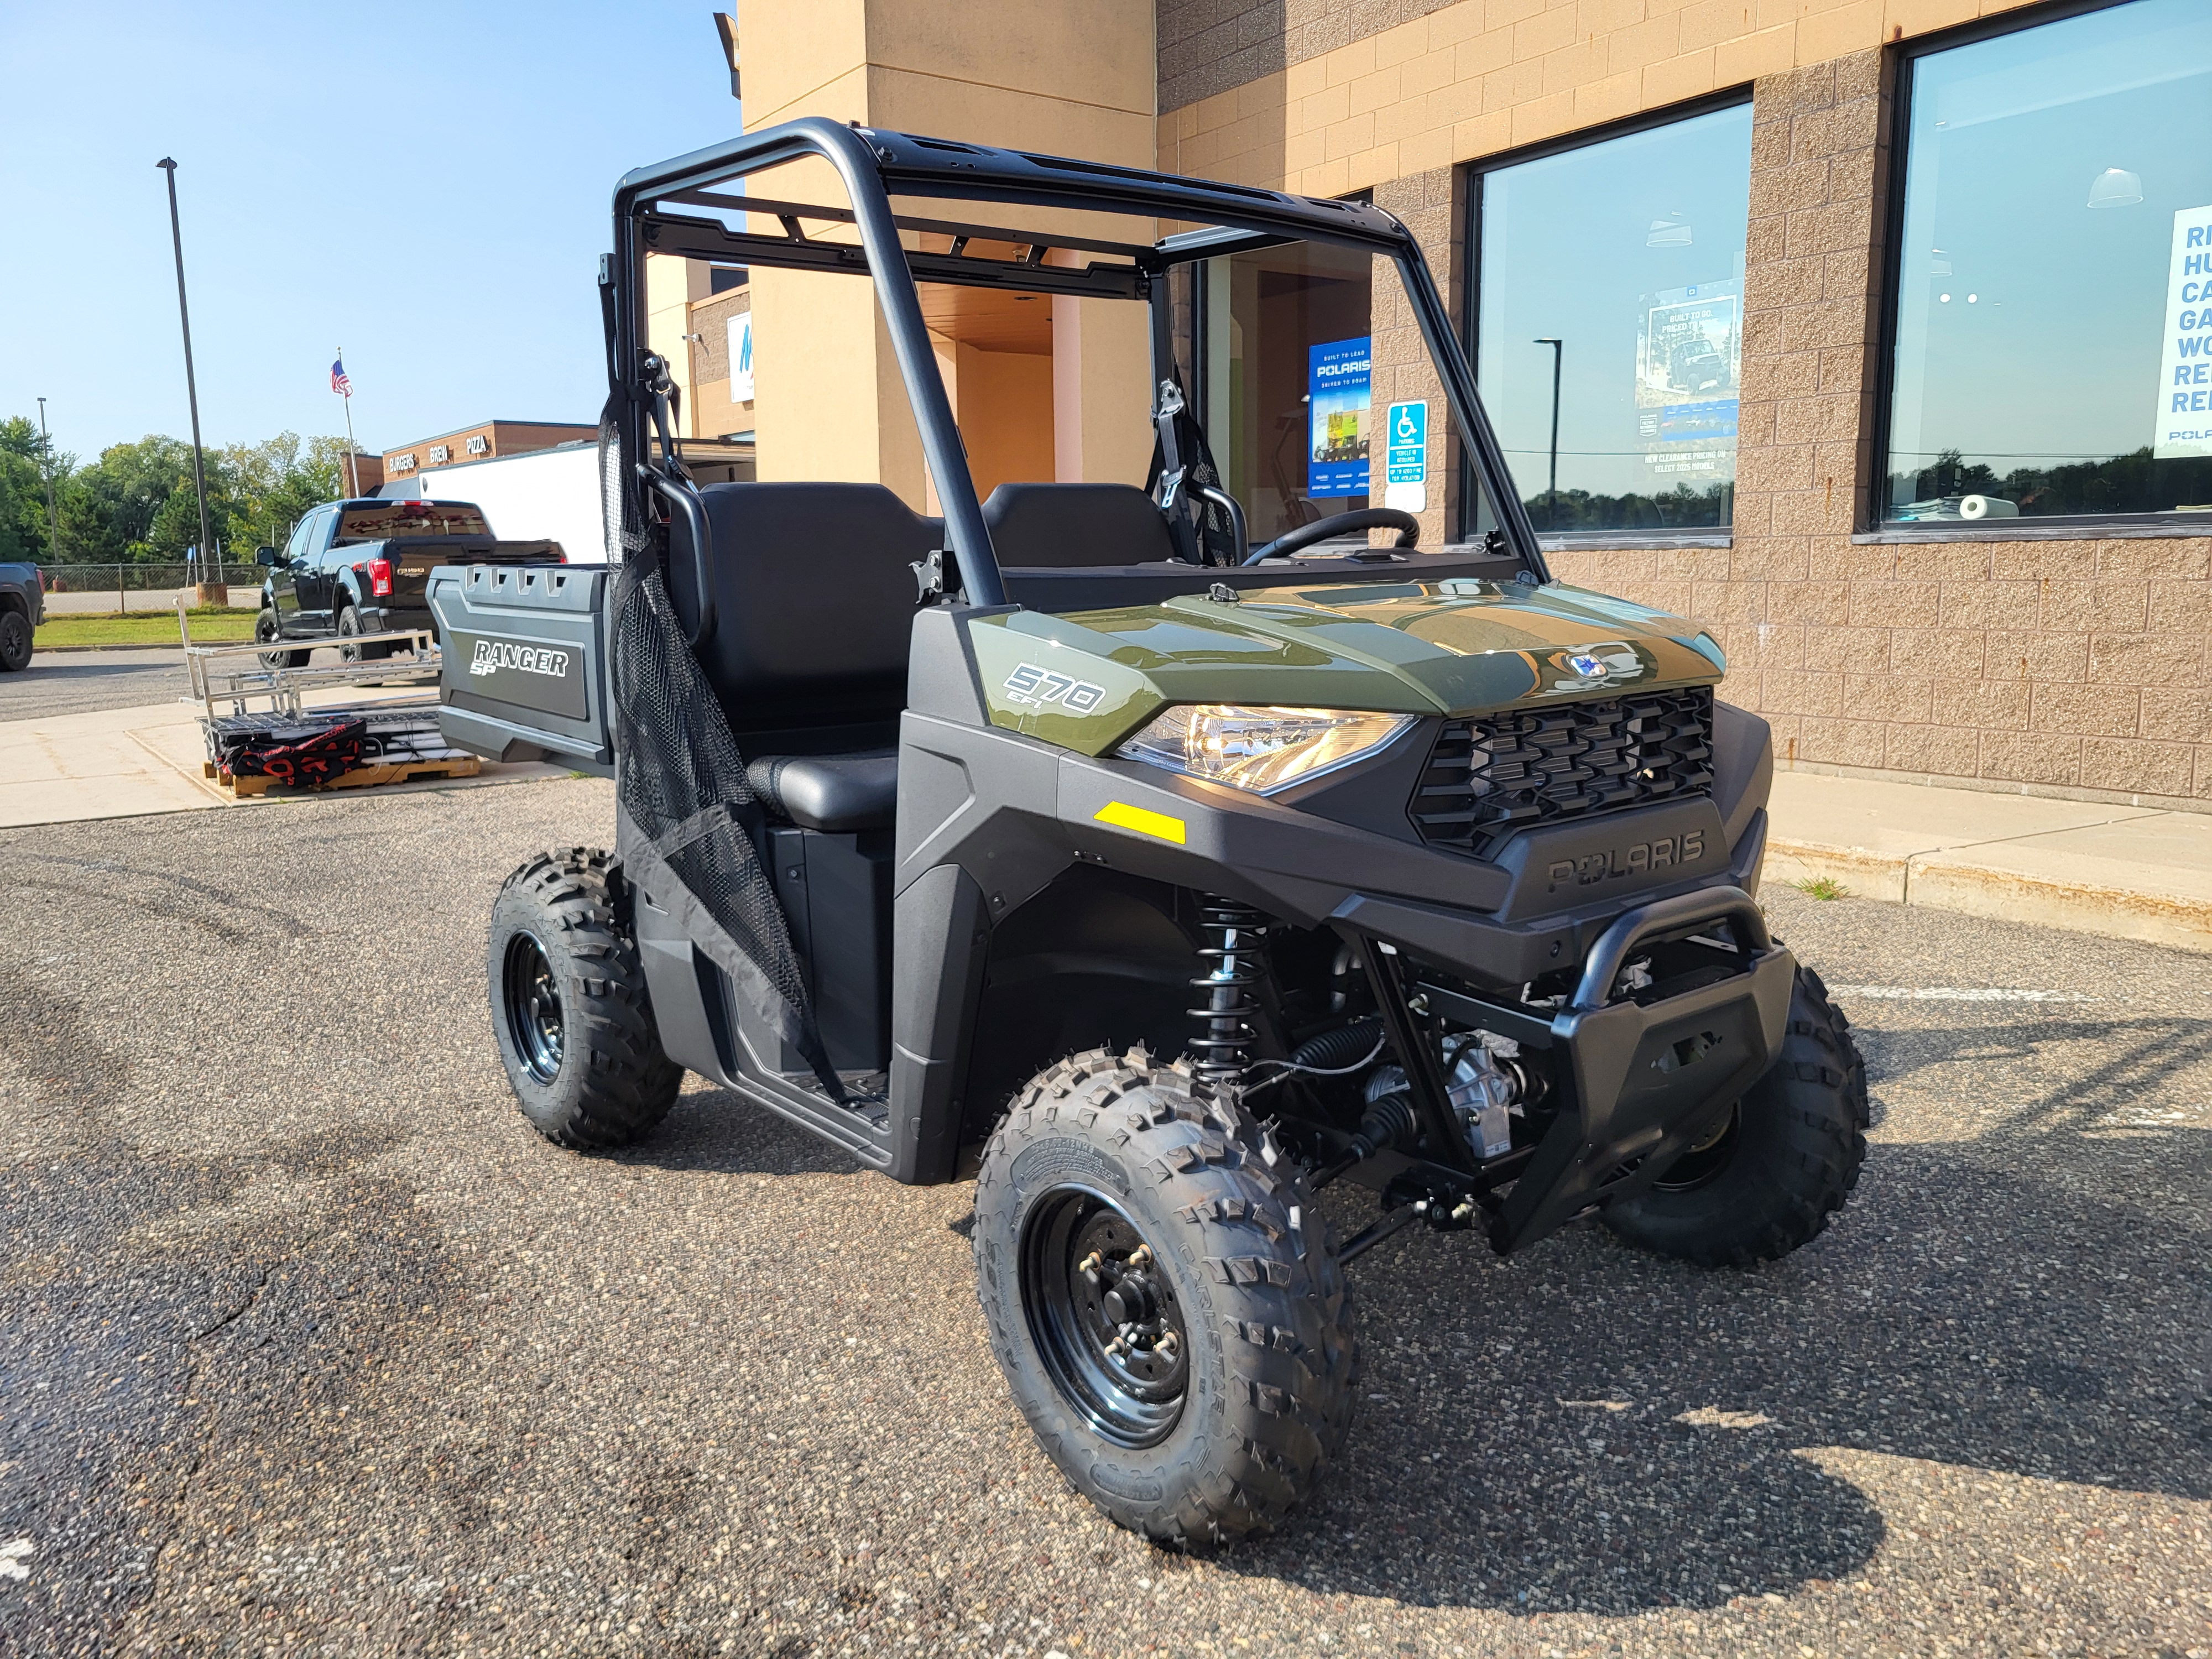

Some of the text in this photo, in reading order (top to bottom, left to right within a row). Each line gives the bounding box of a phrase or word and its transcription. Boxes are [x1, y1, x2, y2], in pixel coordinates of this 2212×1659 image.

[1670, 313, 1689, 323] BUILT
[1691, 311, 1700, 319] TO
[1662, 323, 1687, 333] PRICED
[1688, 321, 1698, 330] TO
[1317, 359, 1370, 377] POLARIS
[389, 435, 486, 472] BURGERS BREW PIZZA
[1645, 450, 1725, 463] NEW CLEARANCE PRICING ON
[1655, 462, 1714, 473] SELECT 2025 MODELS
[474, 640, 569, 677] RANGER
[469, 662, 497, 676] SP
[1002, 661, 1106, 713] 570
[1006, 691, 1043, 709] EFI
[1548, 830, 1704, 893] POLARIS
[1178, 1243, 1225, 1417] CARLSTAR
